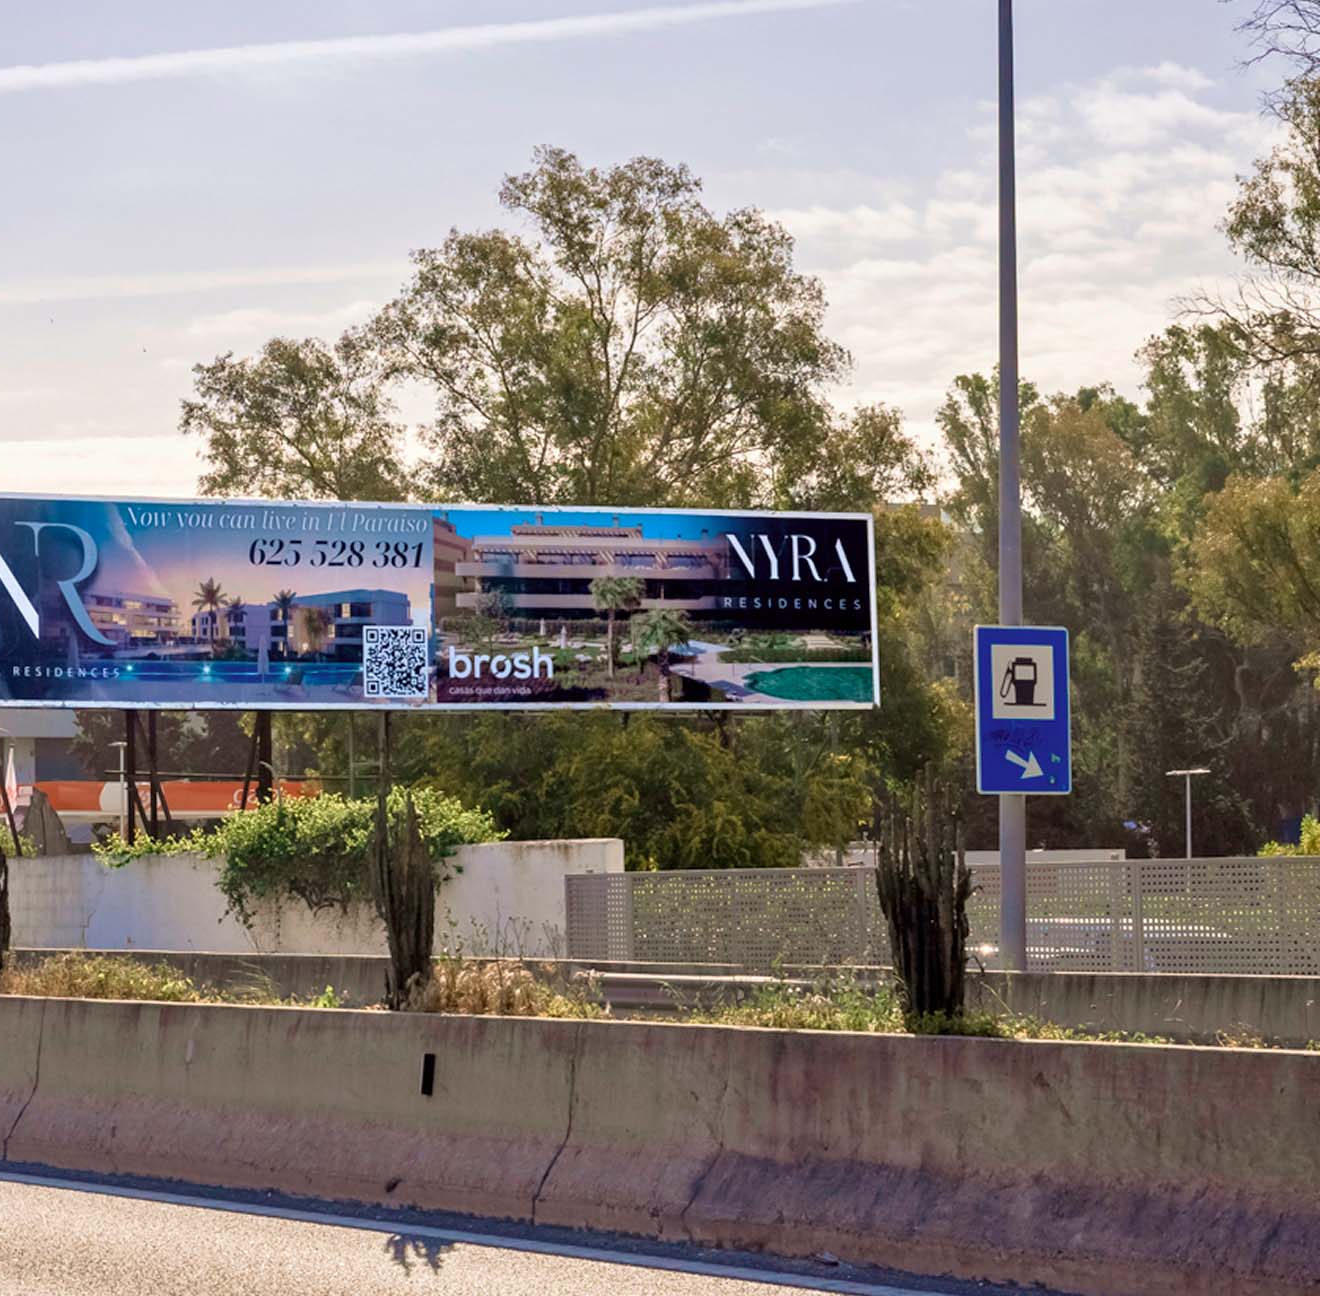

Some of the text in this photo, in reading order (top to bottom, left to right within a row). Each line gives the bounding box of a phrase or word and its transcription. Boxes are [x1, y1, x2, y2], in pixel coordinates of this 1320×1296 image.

[127, 506, 172, 528] Now
[176, 511, 214, 533] you
[219, 513, 256, 529] can
[262, 510, 296, 530] live
[302, 511, 320, 531] in
[327, 511, 347, 531] El
[248, 538, 424, 568] 625 528 381
[725, 533, 857, 583] NYRA
[723, 596, 862, 610] RESIDENCES
[12, 665, 121, 679] RESIDENCES
[448, 645, 554, 679] brosh
[448, 685, 532, 696] casas que dan vida
